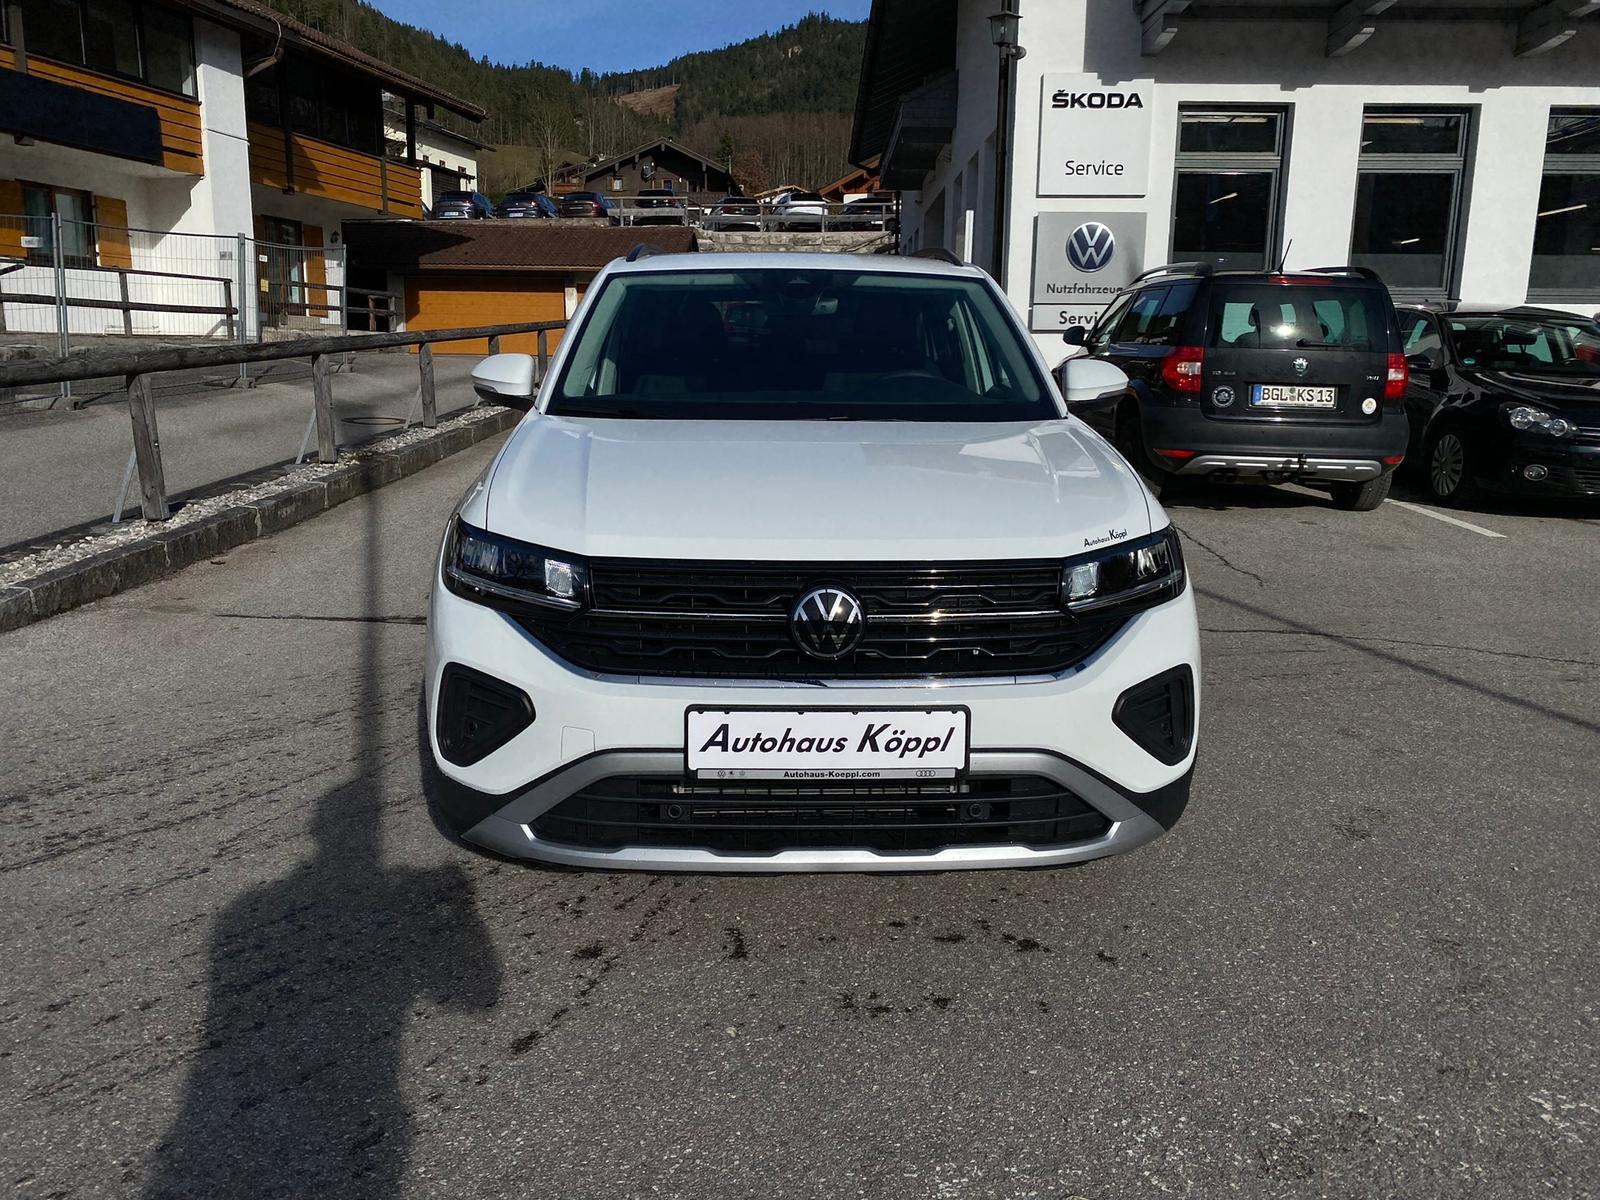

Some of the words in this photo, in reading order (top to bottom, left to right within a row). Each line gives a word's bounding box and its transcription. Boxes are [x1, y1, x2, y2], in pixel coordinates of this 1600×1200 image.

[1051, 89, 1143, 109] ŠKODA
[1065, 160, 1124, 176] Service
[1046, 283, 1123, 294] Nutzfahrzeu
[1059, 311, 1099, 325] Servi
[1262, 387, 1289, 402] BGL
[1084, 537, 1110, 548] Autohaus
[700, 723, 848, 753] Autohaus
[856, 723, 955, 758] Köppl
[783, 770, 880, 779] Autohaus-Koeppl.com
